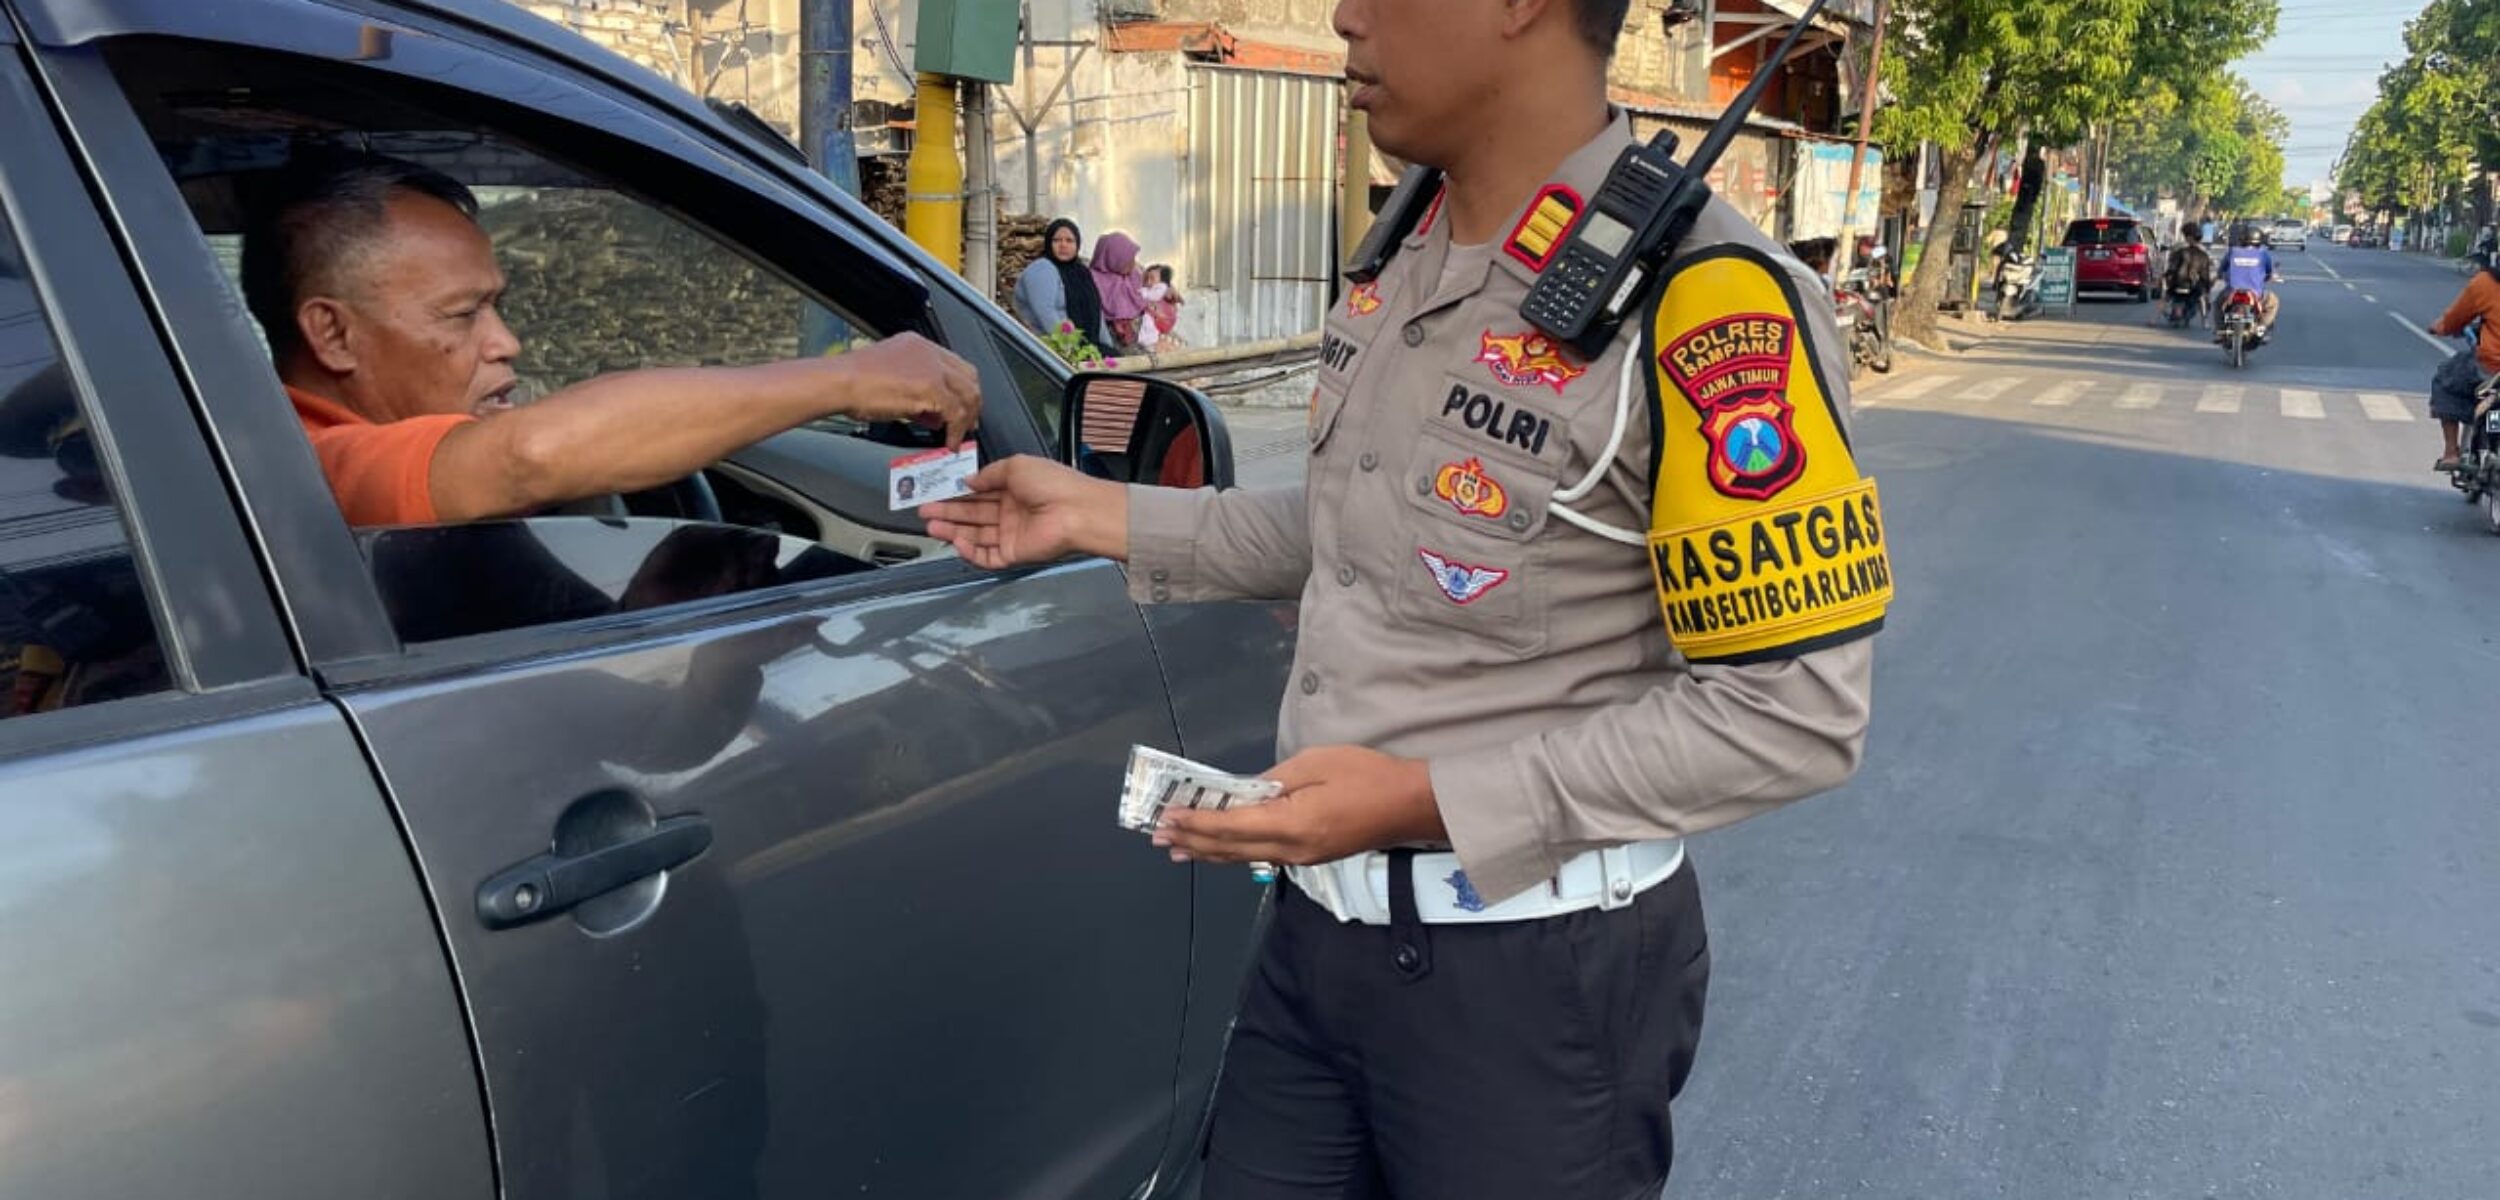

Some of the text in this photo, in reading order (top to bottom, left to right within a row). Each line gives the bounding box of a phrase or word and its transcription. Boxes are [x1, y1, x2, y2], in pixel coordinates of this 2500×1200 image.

[1672, 320, 1783, 367] POLRES
[1684, 339, 1781, 378] SAMPANG
[1701, 368, 1780, 400] JAWA TIMUR
[1442, 383, 1550, 455] POLRI
[1654, 493, 1880, 594] KASATGAS
